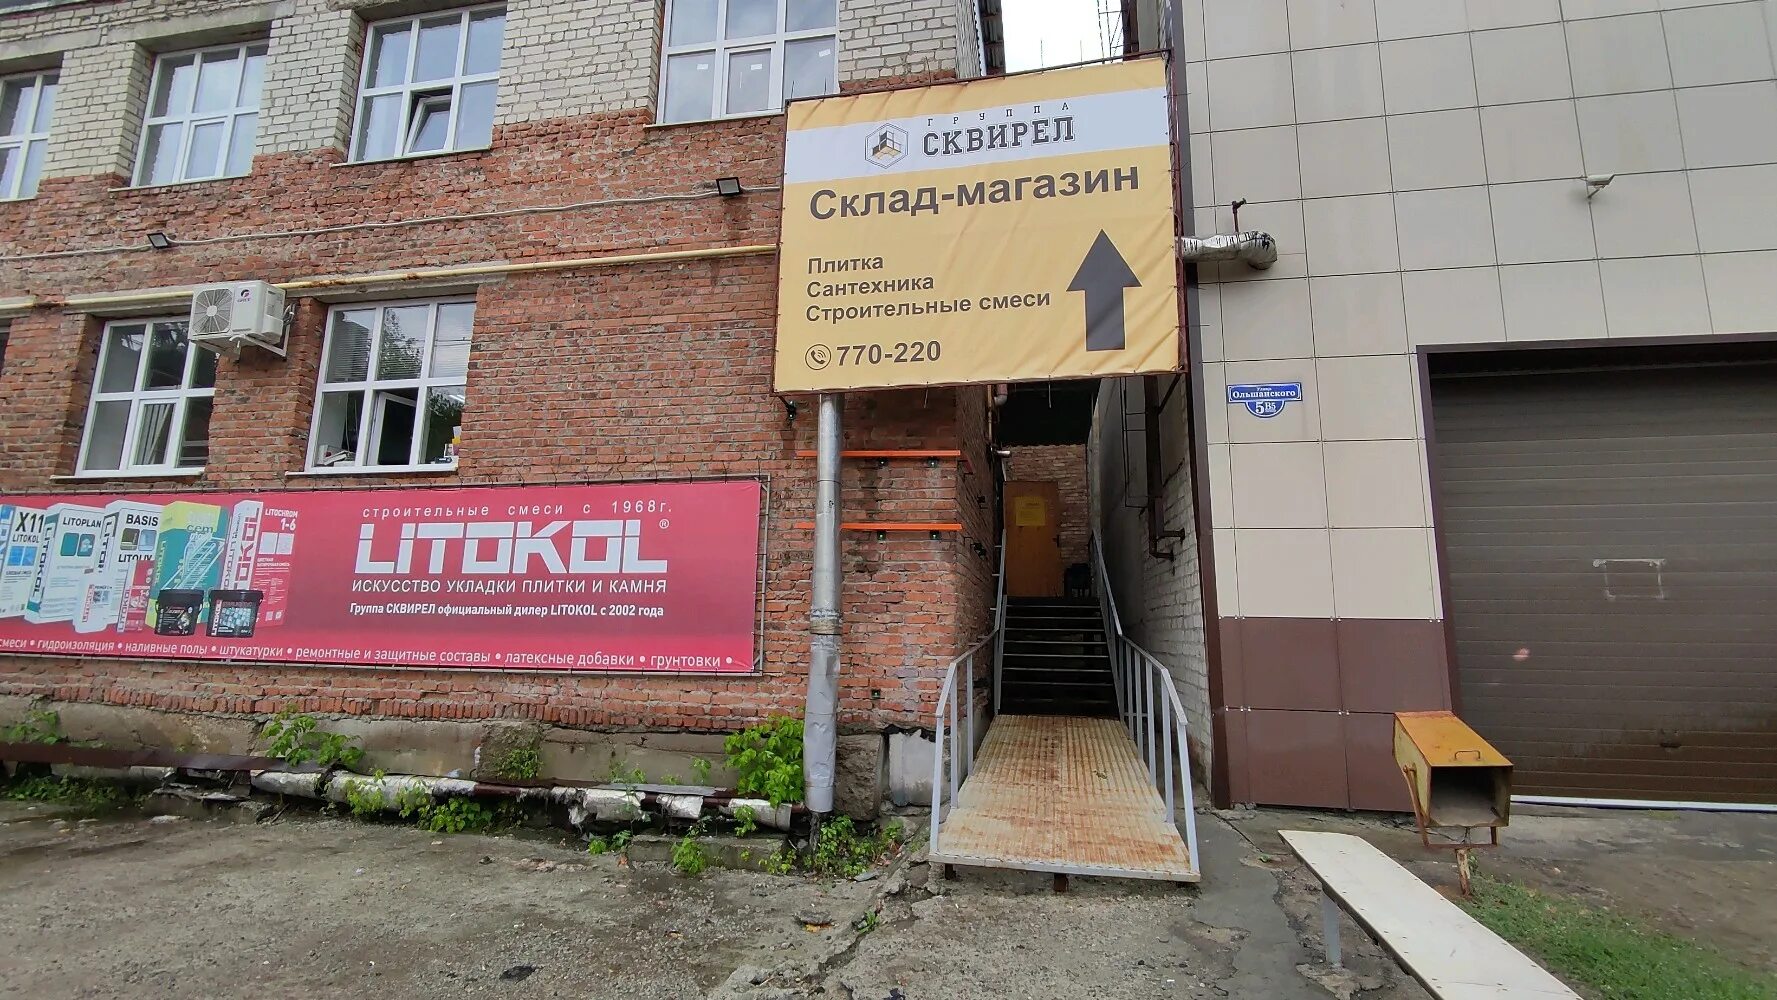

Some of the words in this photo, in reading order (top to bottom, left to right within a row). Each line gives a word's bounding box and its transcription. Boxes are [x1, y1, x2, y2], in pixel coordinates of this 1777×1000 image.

[927, 101, 1070, 127] ГРУППА
[922, 115, 1075, 157] СКВИРЕЛ
[810, 165, 1139, 220] Склад-магазин
[807, 254, 884, 275] Плитка
[806, 274, 935, 298] Сантехника
[805, 294, 971, 324] Строительные
[978, 292, 1051, 311] смеси
[836, 340, 942, 366] 770-220
[1233, 390, 1295, 398] Ольшанского
[1256, 401, 1264, 414] 5
[126, 513, 159, 527] BASIS
[265, 508, 298, 518] LITOCHROM
[362, 504, 490, 521] строительные
[508, 504, 564, 516] смеси
[583, 503, 591, 514] с
[611, 500, 672, 514] 1968г.
[15, 511, 45, 533] X11
[62, 517, 102, 528] LITOPLAN
[280, 518, 297, 531] 1-6
[12, 534, 40, 543] LITOKOL
[354, 519, 668, 574] LITOKOL
[352, 579, 441, 593] ИСКУССТВО
[446, 579, 516, 595] УКЛАДКИ
[522, 579, 585, 593] ПЛИТКИ
[592, 579, 603, 593] И
[609, 579, 667, 593] КАМНЯ
[350, 602, 384, 617] Группа
[386, 603, 436, 615] СКВИРЕЛ
[437, 602, 513, 617] официальный
[514, 604, 548, 618] дилер
[550, 604, 598, 616] LITOKOL
[600, 607, 607, 616] с
[608, 604, 636, 616] 2002
[638, 606, 665, 618] года
[37, 640, 115, 652] гидроизоляция
[125, 642, 178, 653] наливные
[180, 643, 208, 655] полы
[219, 644, 284, 658] штукатурки
[295, 646, 361, 662] ремонтные
[364, 648, 372, 659] и
[374, 648, 437, 664] защитные
[439, 650, 491, 663] составы
[504, 651, 574, 666] латексные
[577, 652, 635, 667] добавки
[650, 654, 722, 670] грунтовки
